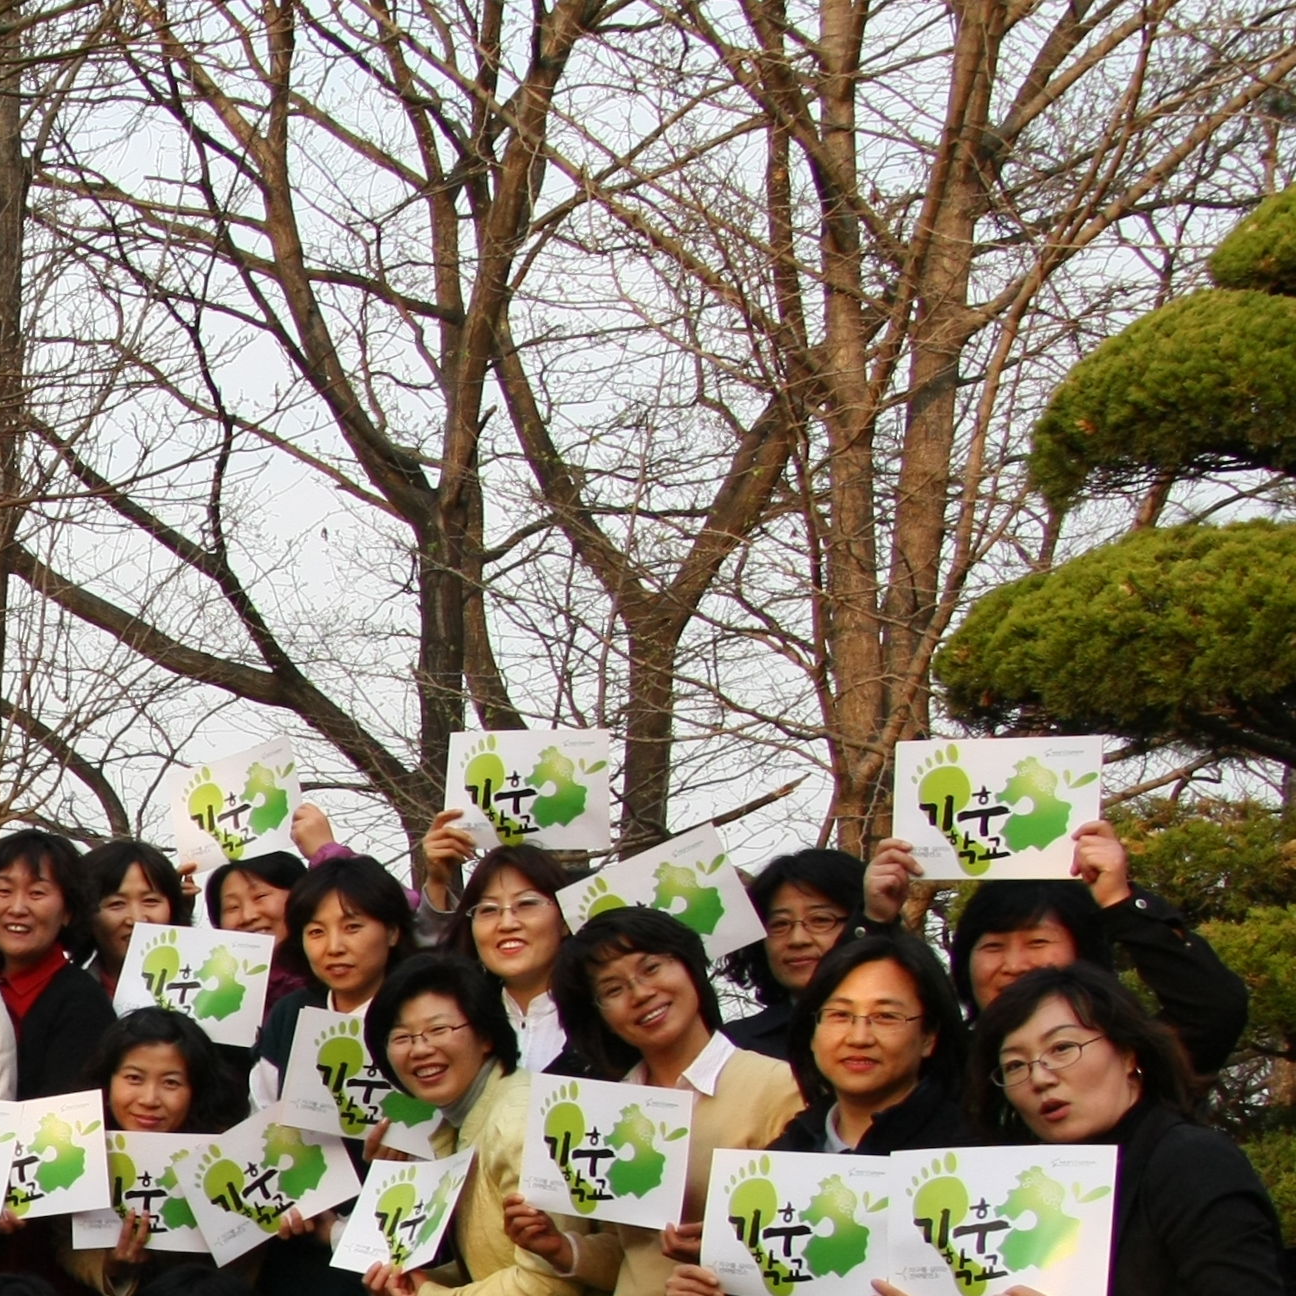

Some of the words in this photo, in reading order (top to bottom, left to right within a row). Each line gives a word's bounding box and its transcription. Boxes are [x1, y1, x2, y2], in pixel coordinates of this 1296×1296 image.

[190, 789, 255, 835] 기후
[465, 776, 537, 813] 기후
[919, 785, 1010, 835] 기후
[207, 825, 259, 854] 학교
[485, 807, 540, 837] 학교
[944, 831, 1012, 864] 학교
[141, 966, 201, 1006] 기후
[11, 1140, 40, 1185] 후
[543, 1126, 616, 1168] 기후
[210, 1162, 279, 1213] 기후
[565, 1167, 616, 1204] 학교
[375, 1201, 427, 1240] 기후
[728, 1202, 813, 1257] 기후
[914, 1198, 1012, 1254] 기후
[751, 1248, 814, 1286] 학교
[943, 1246, 1008, 1286] 학교
